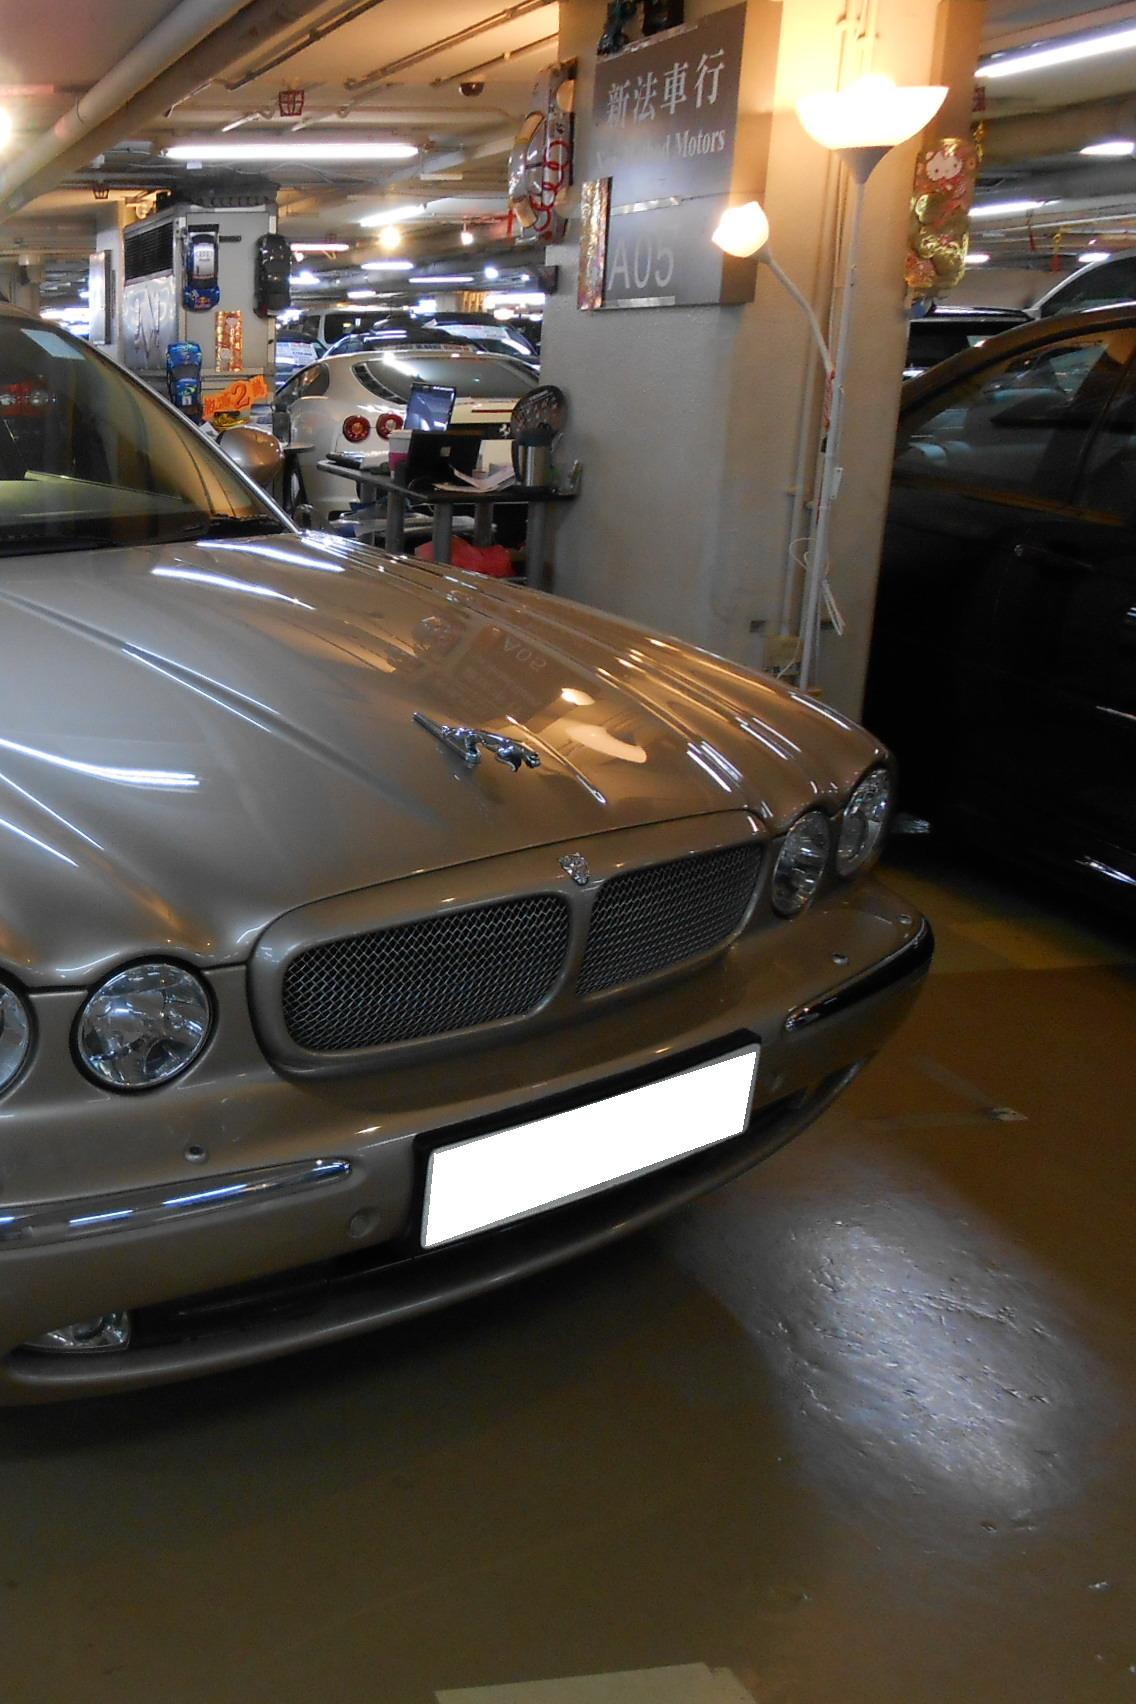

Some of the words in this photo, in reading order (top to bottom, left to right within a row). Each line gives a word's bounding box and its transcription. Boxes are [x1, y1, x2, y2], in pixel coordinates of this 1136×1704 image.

[607, 49, 726, 128] 新法車行
[675, 128, 726, 158] Motors
[607, 229, 675, 291] A05
